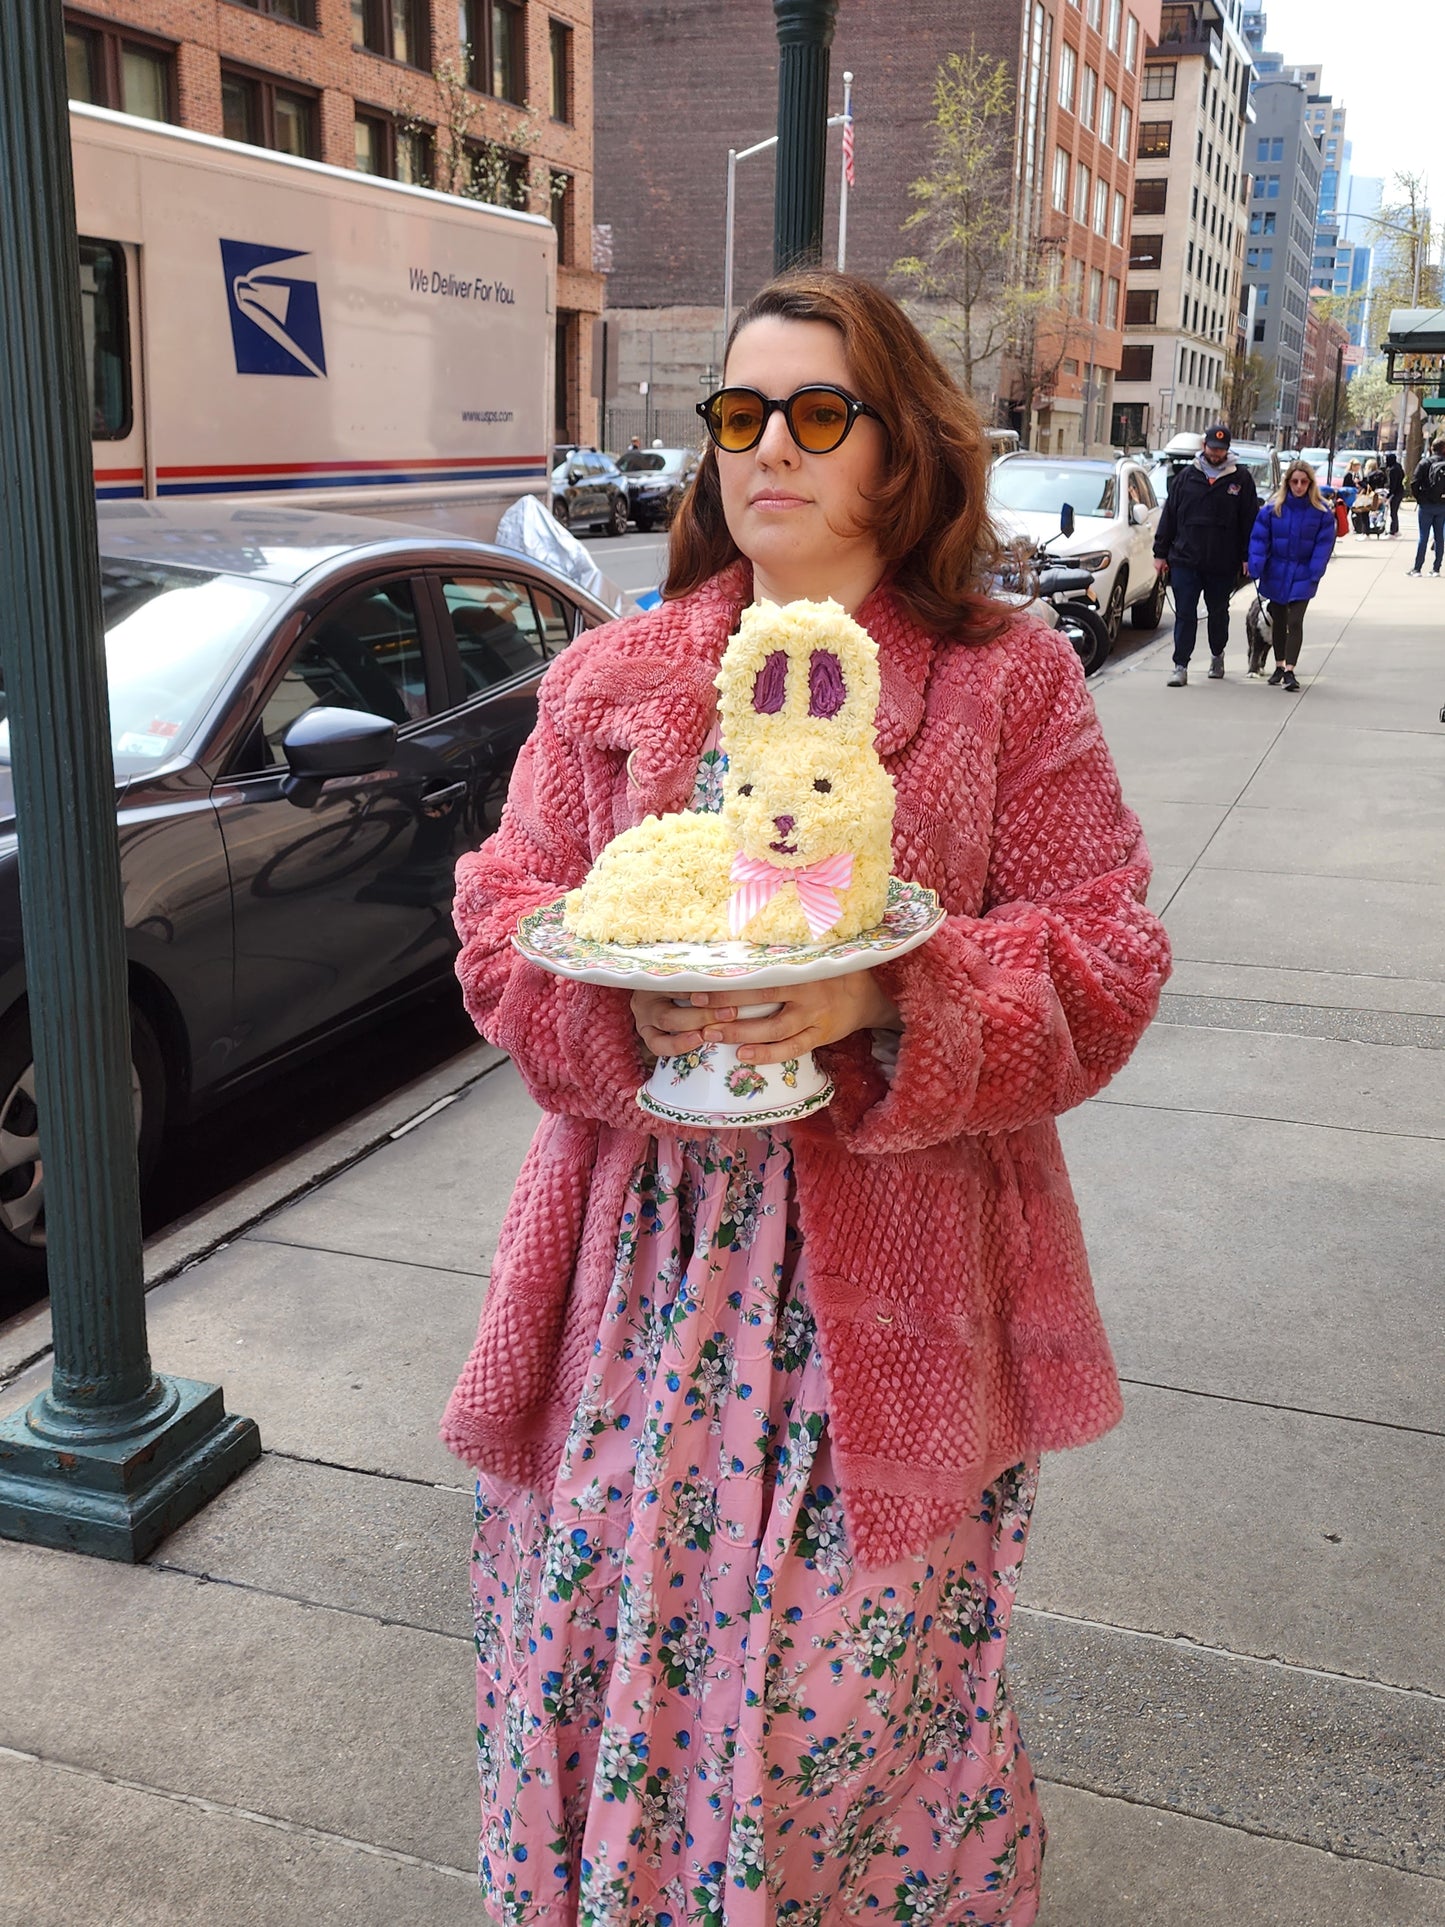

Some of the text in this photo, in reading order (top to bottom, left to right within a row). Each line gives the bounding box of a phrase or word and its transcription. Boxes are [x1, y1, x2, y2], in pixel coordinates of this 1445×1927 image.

[409, 267, 428, 292] We
[431, 271, 472, 298] Deliver
[474, 278, 493, 301] For
[462, 410, 513, 425] www.usps.com
